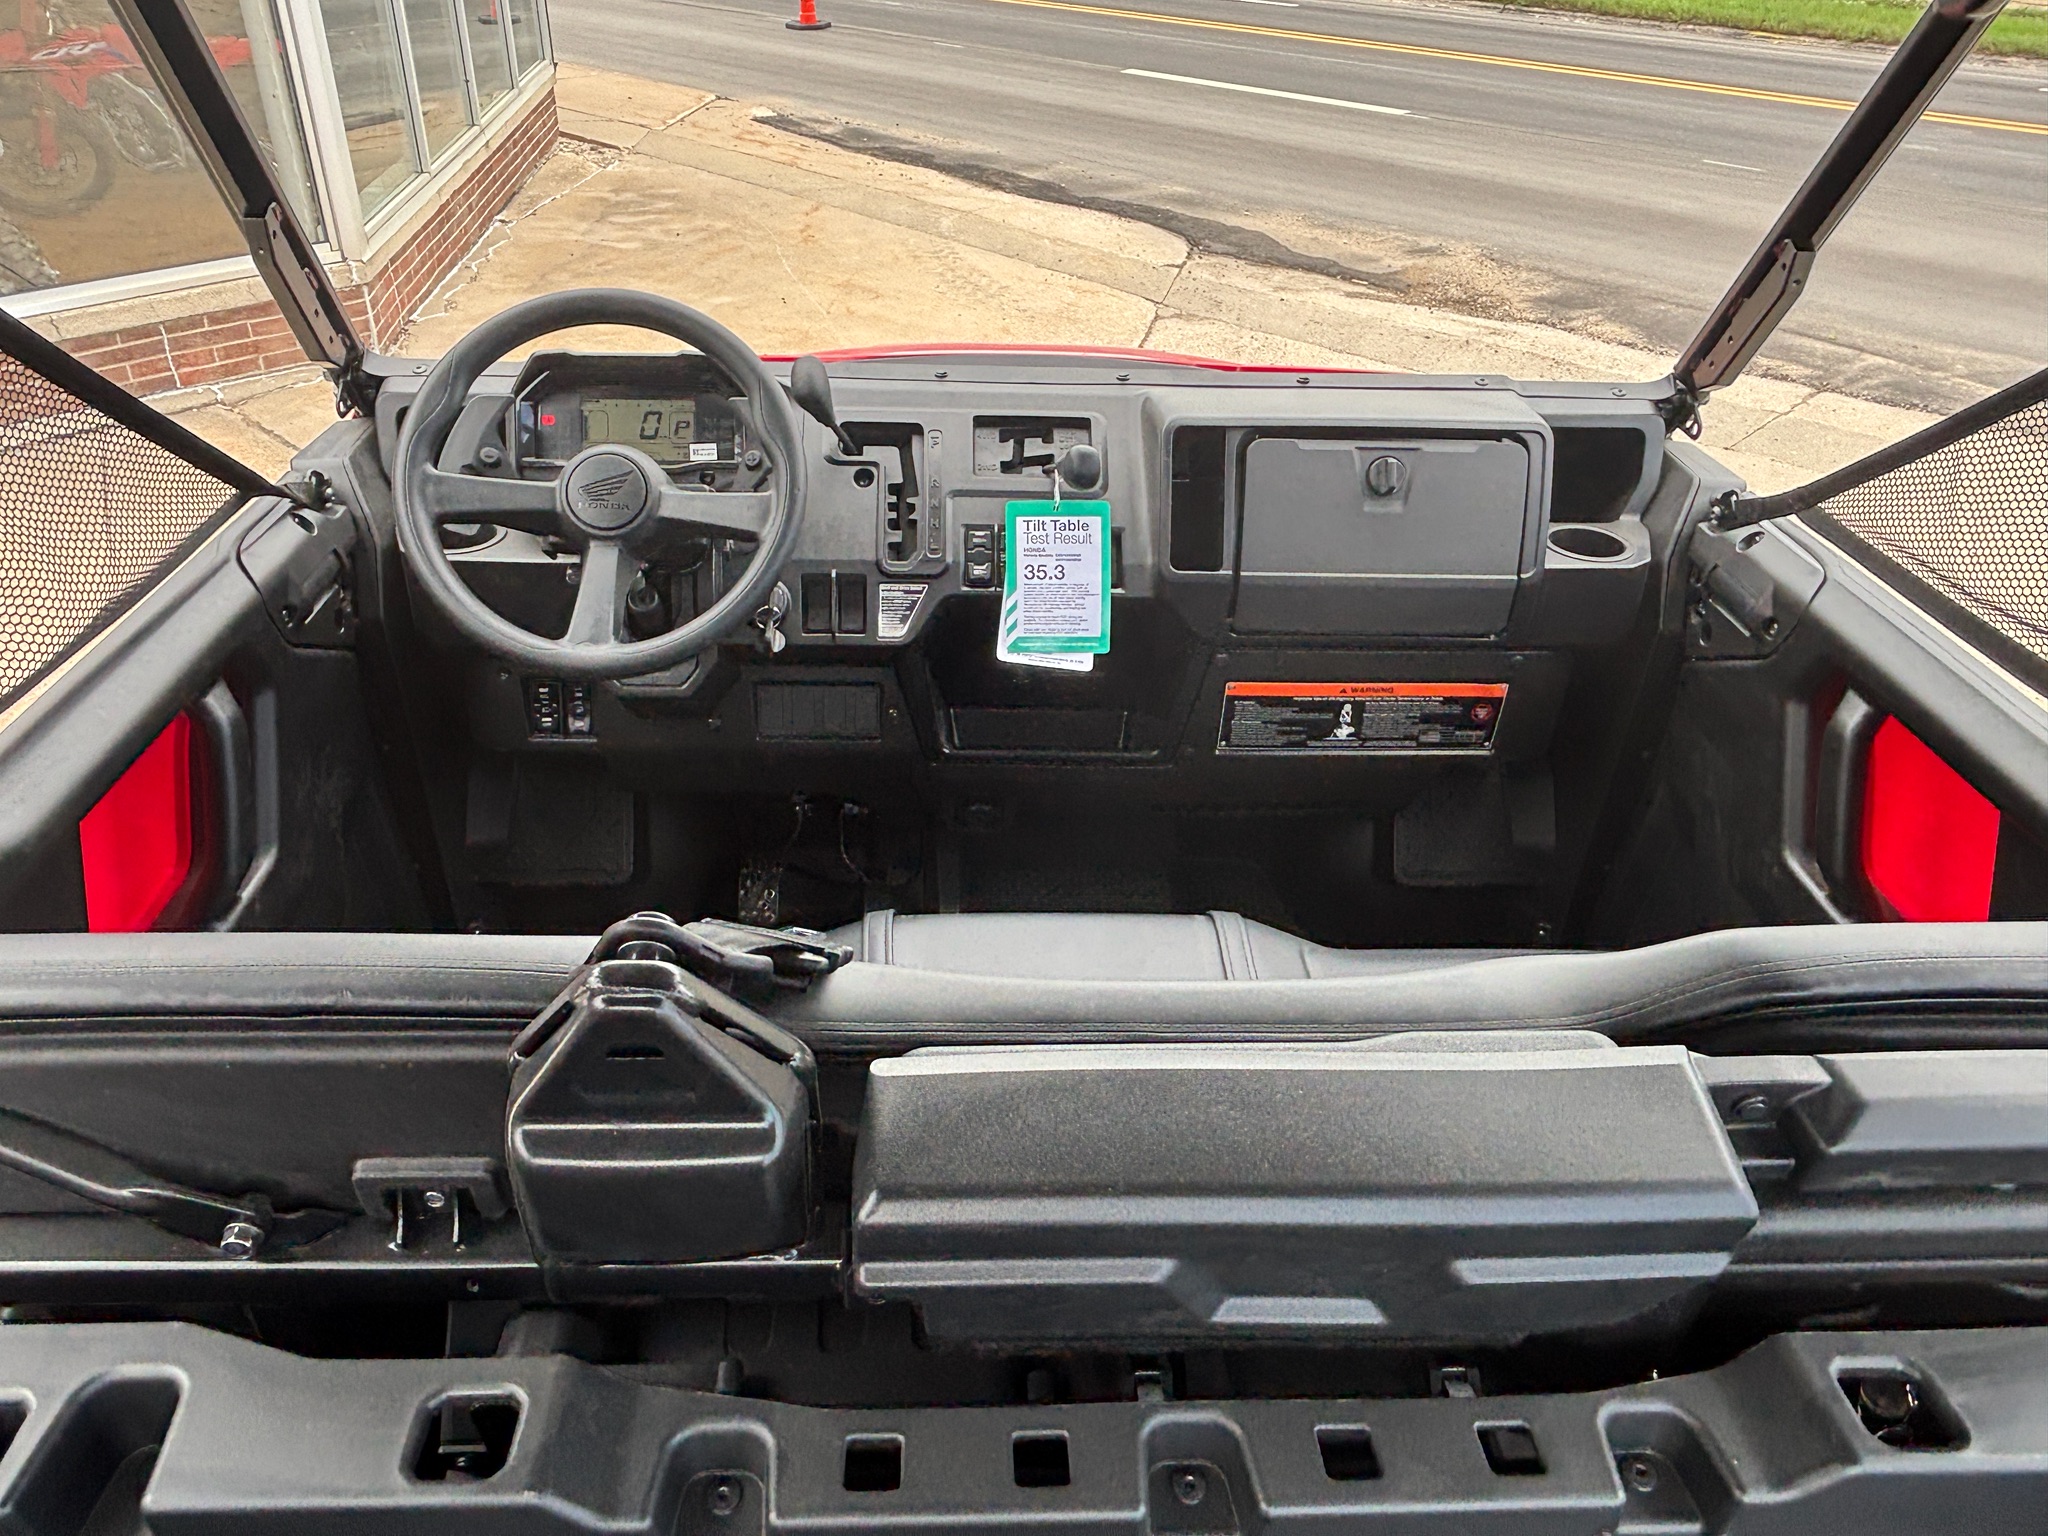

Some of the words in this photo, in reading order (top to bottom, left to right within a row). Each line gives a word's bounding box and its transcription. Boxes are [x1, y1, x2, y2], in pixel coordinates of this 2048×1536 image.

[639, 410, 662, 439] 0
[674, 420, 690, 436] P
[1022, 519, 1047, 532] Tilt
[1050, 519, 1090, 532] Table
[1023, 532, 1050, 545] Test
[1053, 532, 1093, 545] Result
[1023, 564, 1066, 581] 35.3
[1350, 686, 1394, 694] WARNING
